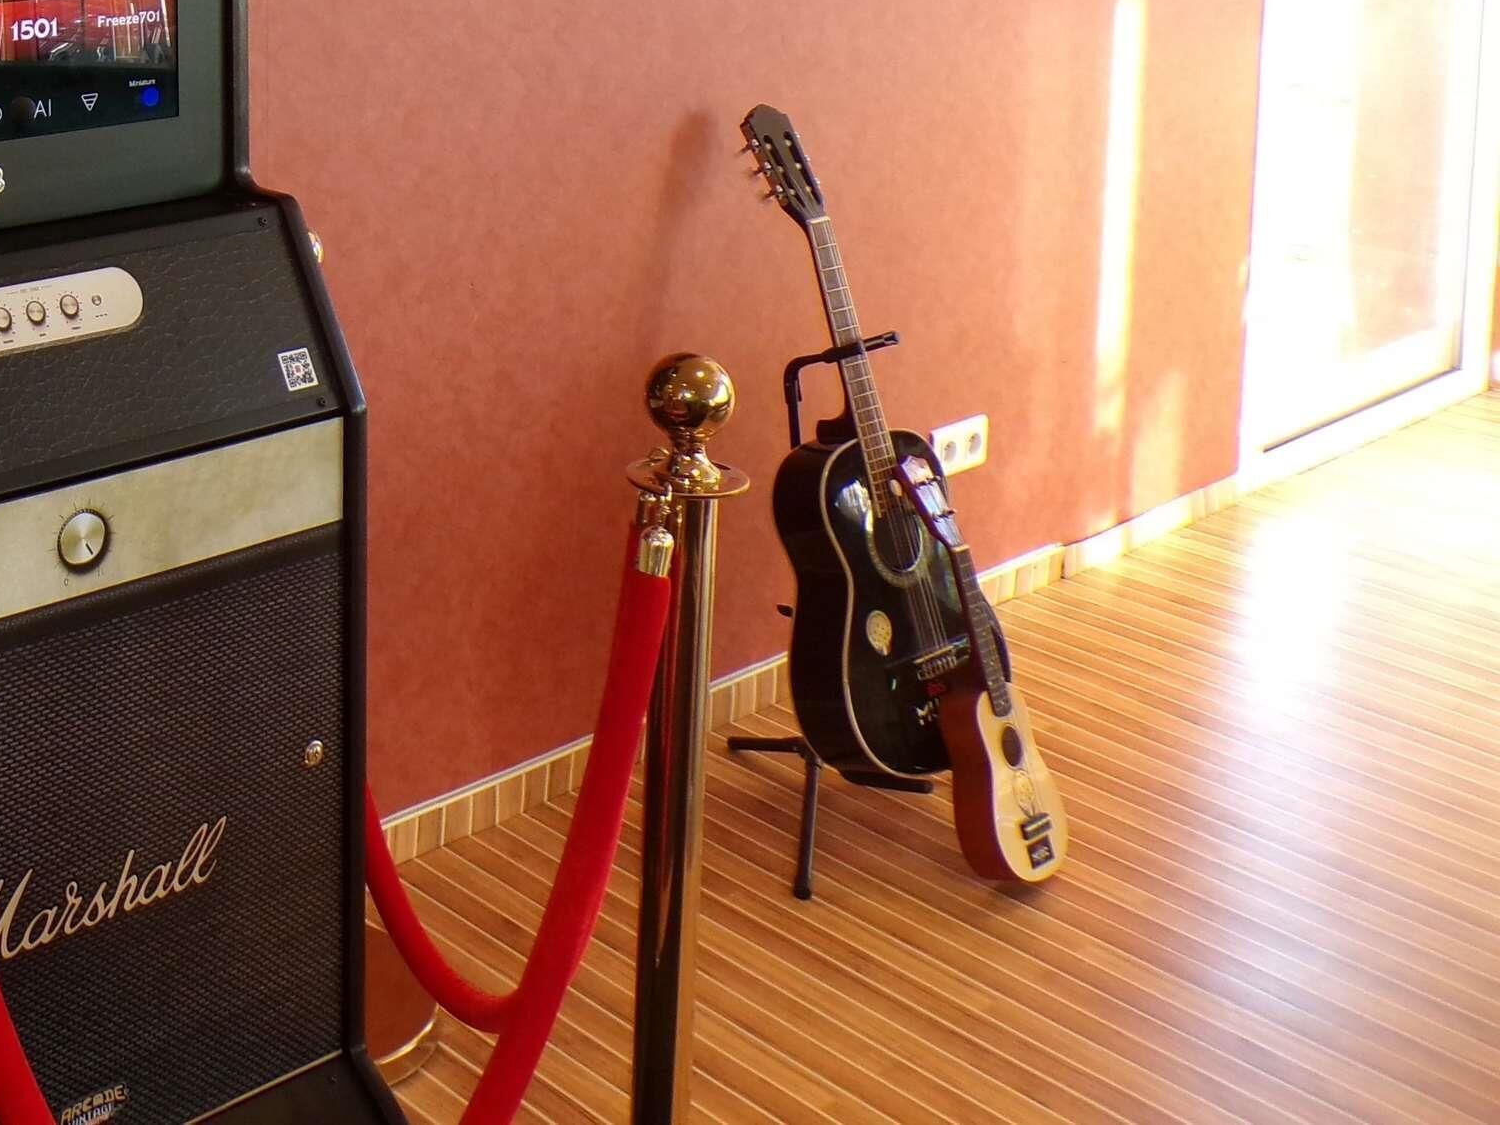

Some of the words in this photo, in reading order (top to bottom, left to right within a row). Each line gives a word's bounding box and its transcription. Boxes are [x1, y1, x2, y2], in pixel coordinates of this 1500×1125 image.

[11, 18, 59, 42] 1501
[97, 11, 161, 28] Freeze701
[61, 1084, 127, 1125] ARCADE
